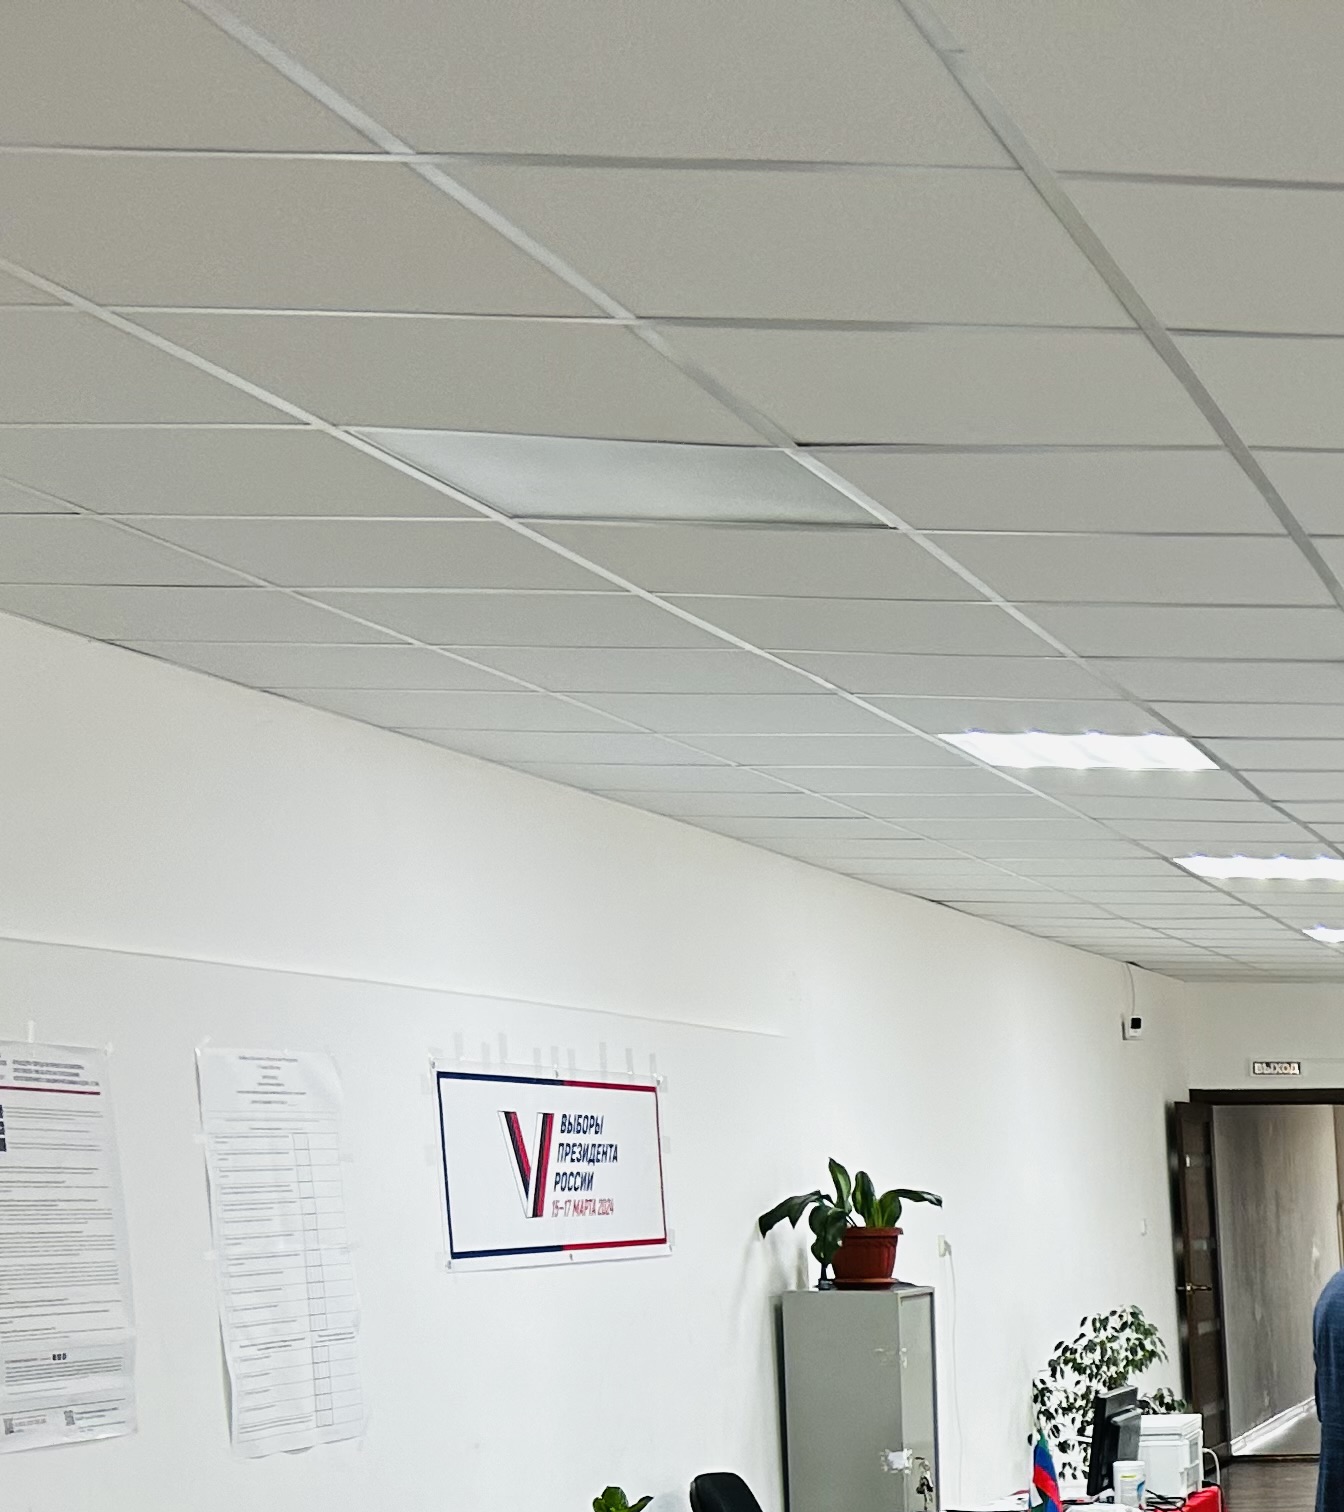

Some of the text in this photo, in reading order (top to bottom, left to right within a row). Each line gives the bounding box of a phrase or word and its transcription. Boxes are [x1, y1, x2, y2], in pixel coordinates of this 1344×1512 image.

[1254, 1062, 1300, 1075] ВЫХОД
[560, 1113, 604, 1135] ВЫБОРЫ
[556, 1142, 618, 1166] ПРЕЗИДЕНТА
[553, 1171, 595, 1192] РОССИИ
